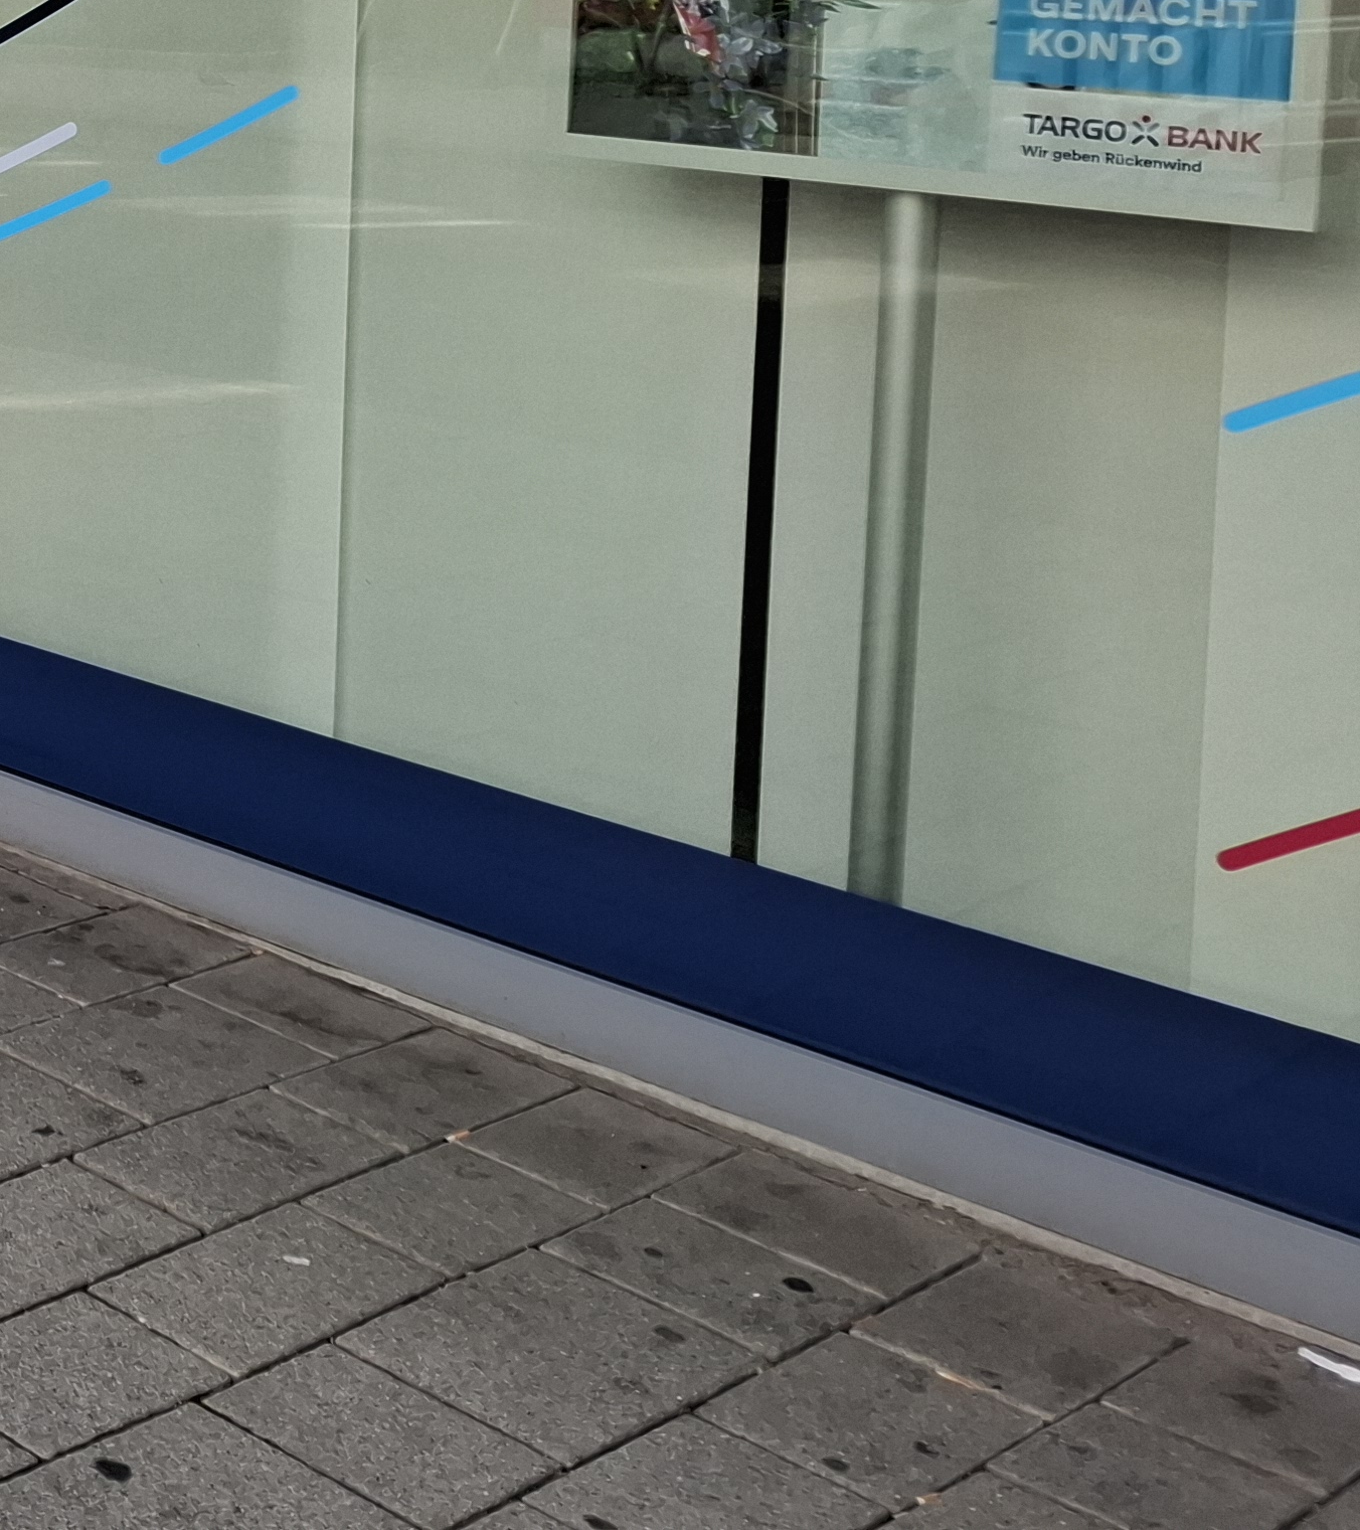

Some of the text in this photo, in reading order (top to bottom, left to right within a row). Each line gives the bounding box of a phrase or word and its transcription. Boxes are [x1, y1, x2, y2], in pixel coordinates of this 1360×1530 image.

[1027, 28, 1182, 66] KONTO
[1023, 113, 1263, 154] TARGO BANK
[1021, 144, 1203, 173] Wir geben Rückenwind
